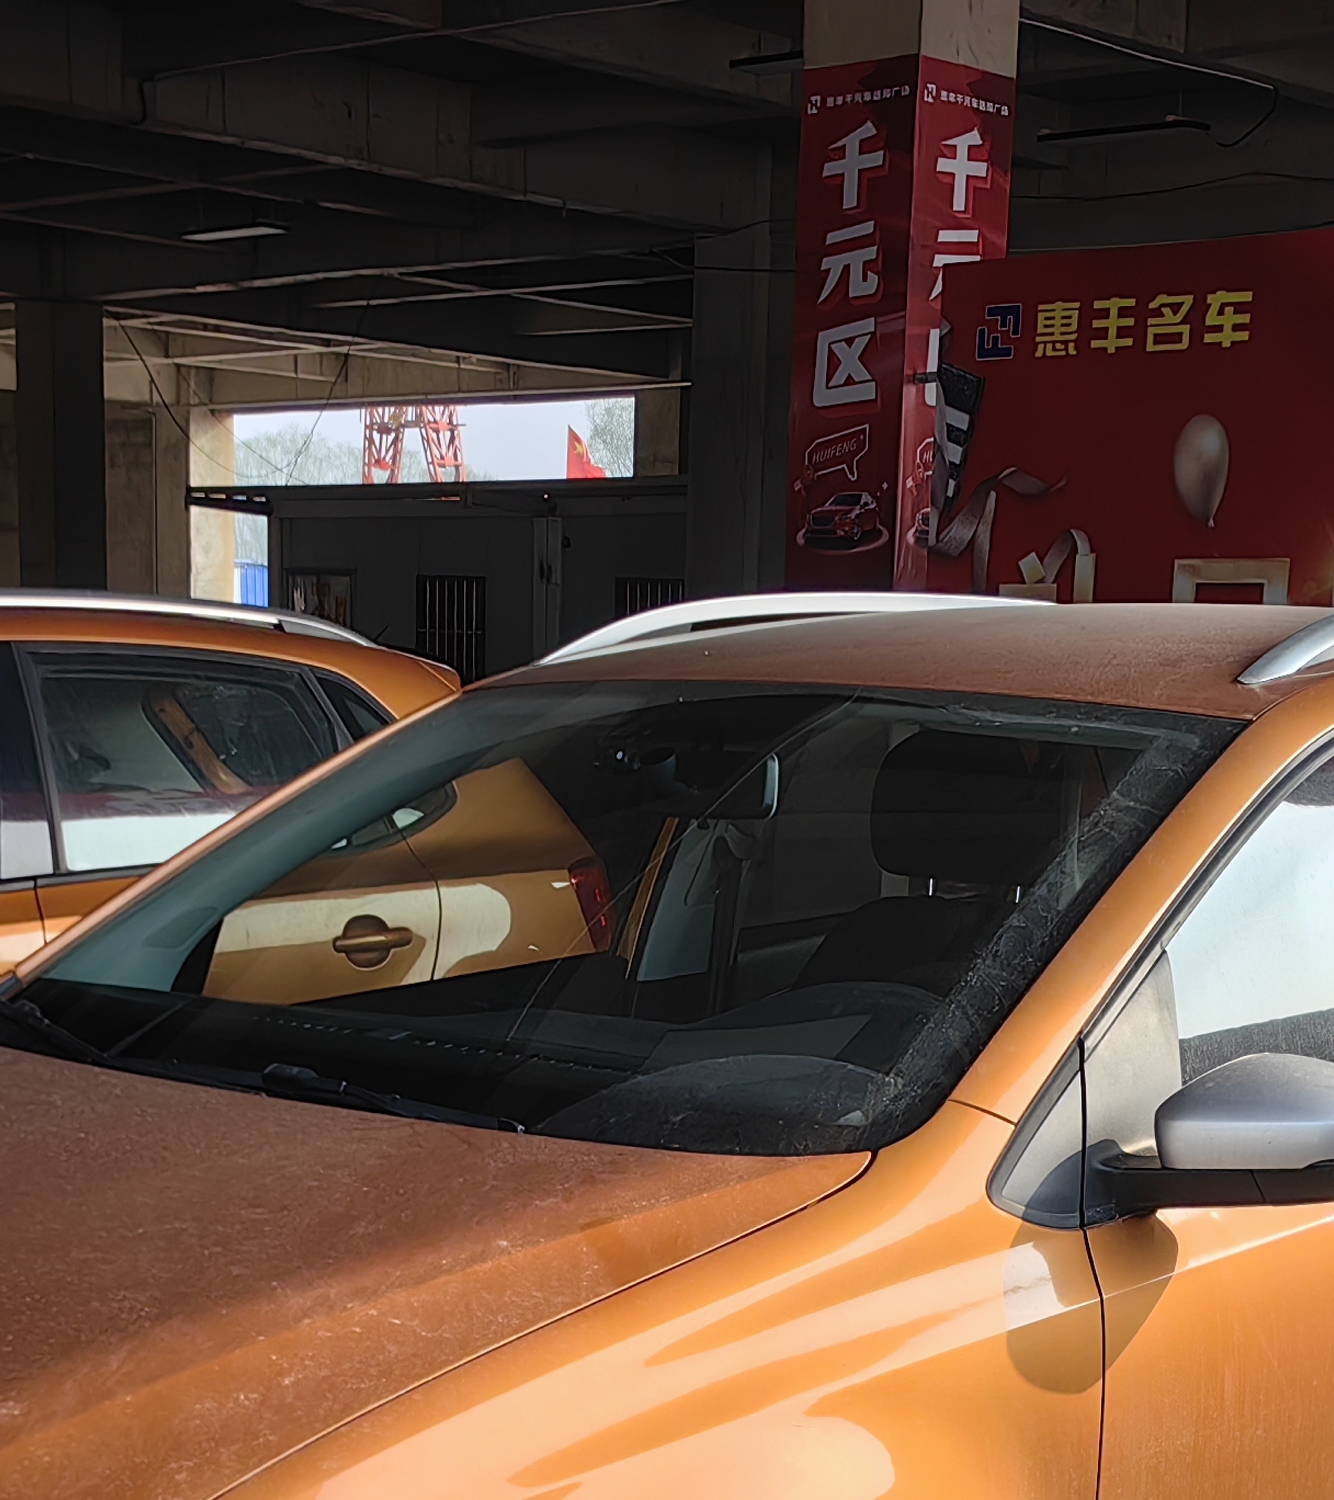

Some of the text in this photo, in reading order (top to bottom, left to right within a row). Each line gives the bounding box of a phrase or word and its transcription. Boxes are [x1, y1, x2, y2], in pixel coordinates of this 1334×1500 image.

[812, 120, 884, 408] 千元区
[1033, 289, 1254, 358] 惠丰名车
[812, 438, 857, 464] HUIFENG
